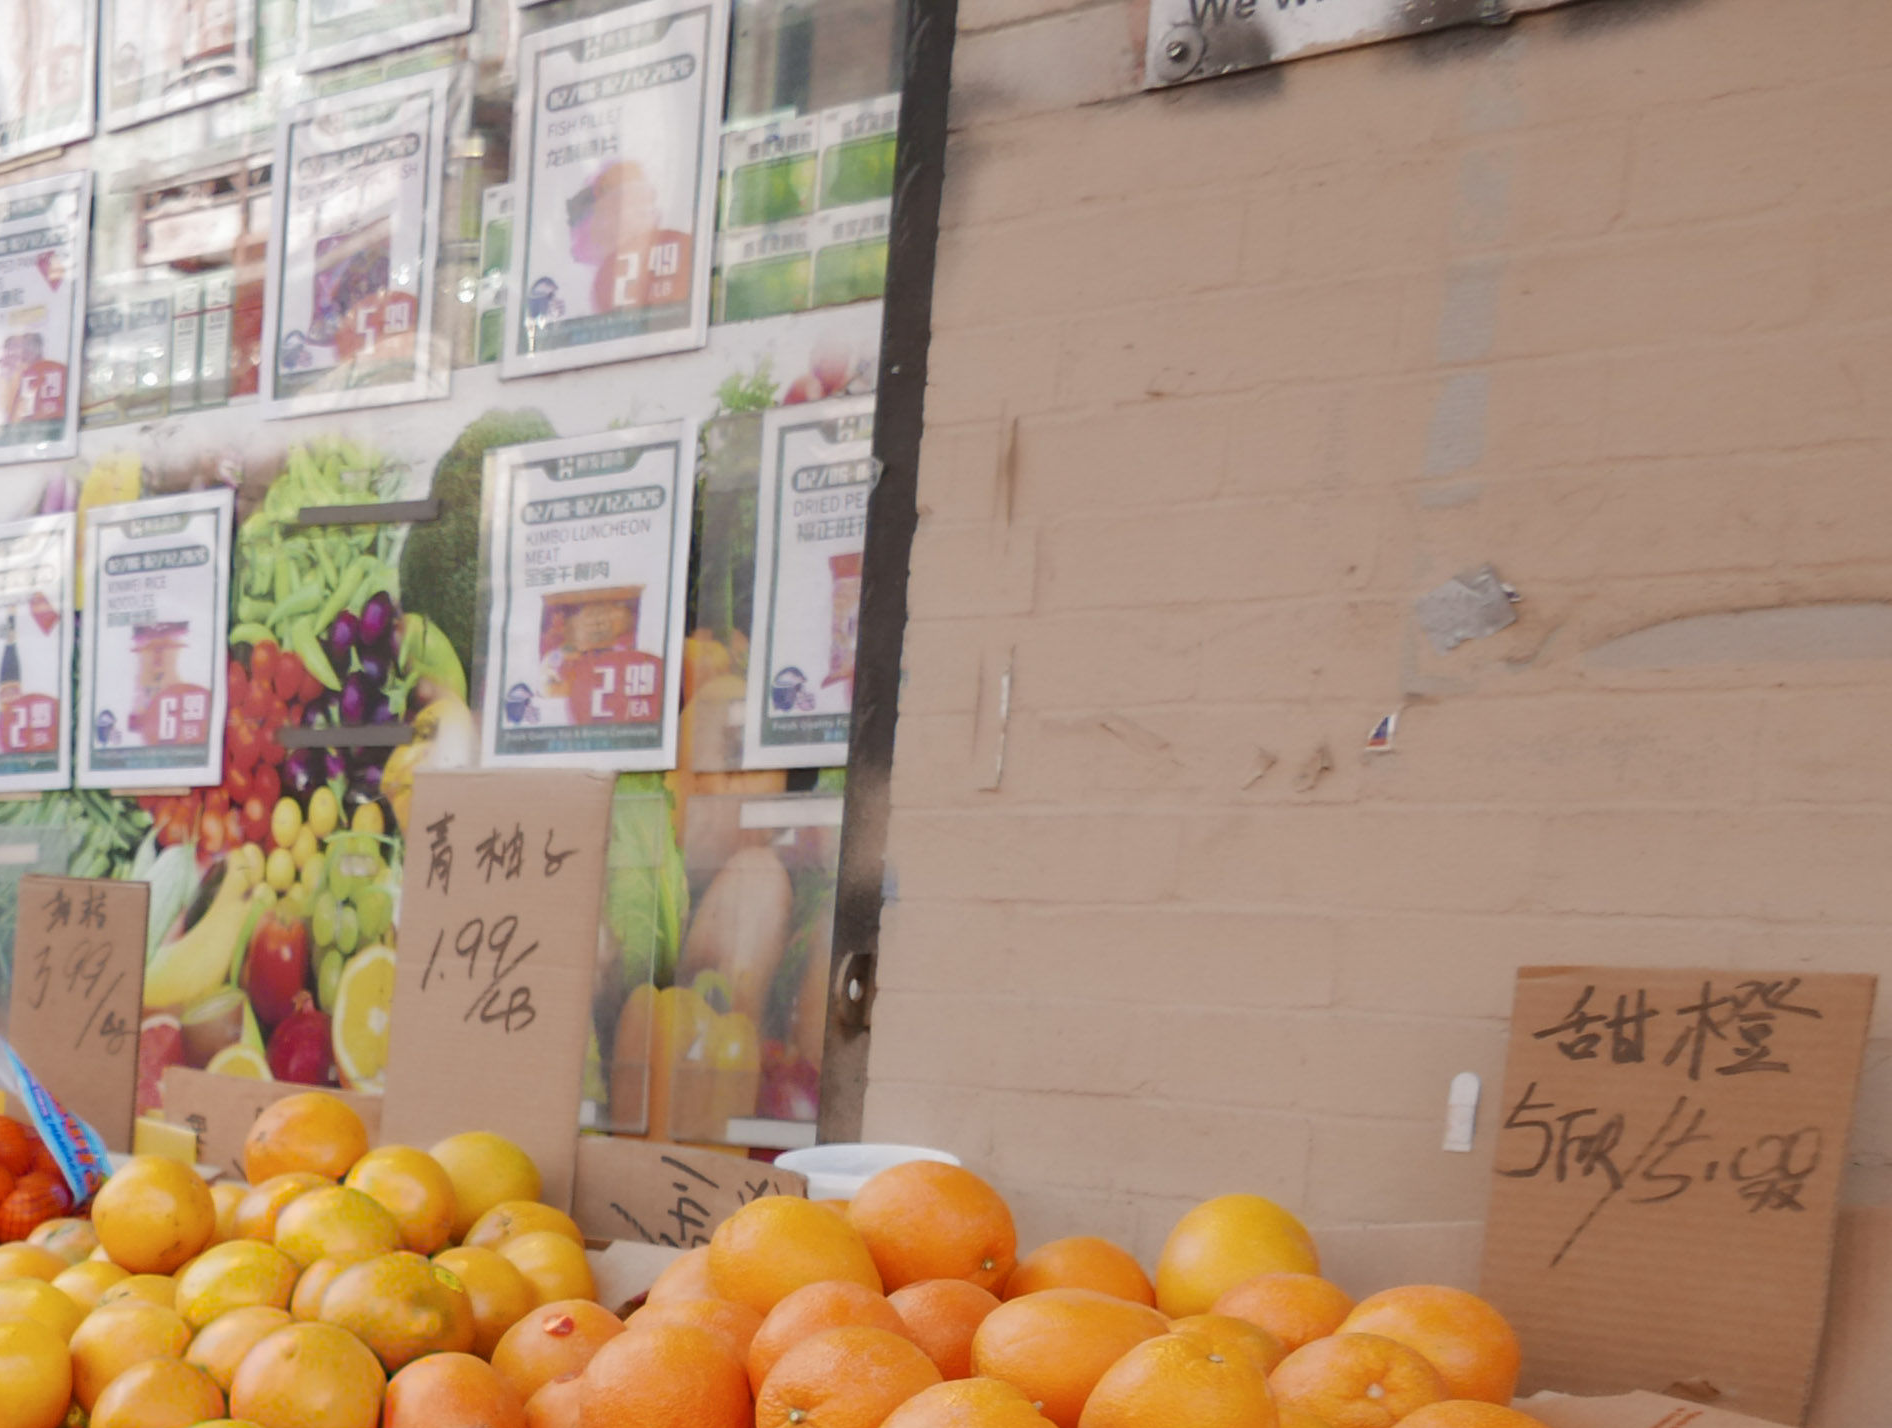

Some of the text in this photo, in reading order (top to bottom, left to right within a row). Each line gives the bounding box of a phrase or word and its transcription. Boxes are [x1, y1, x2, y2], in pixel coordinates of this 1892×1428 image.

[793, 491, 866, 518] DRIED PE
[572, 517, 651, 542] LUNCHEON
[525, 546, 560, 565] MEAT
[592, 666, 614, 718] 2
[625, 662, 656, 696] 99
[1532, 977, 1823, 1082] 甜橙
